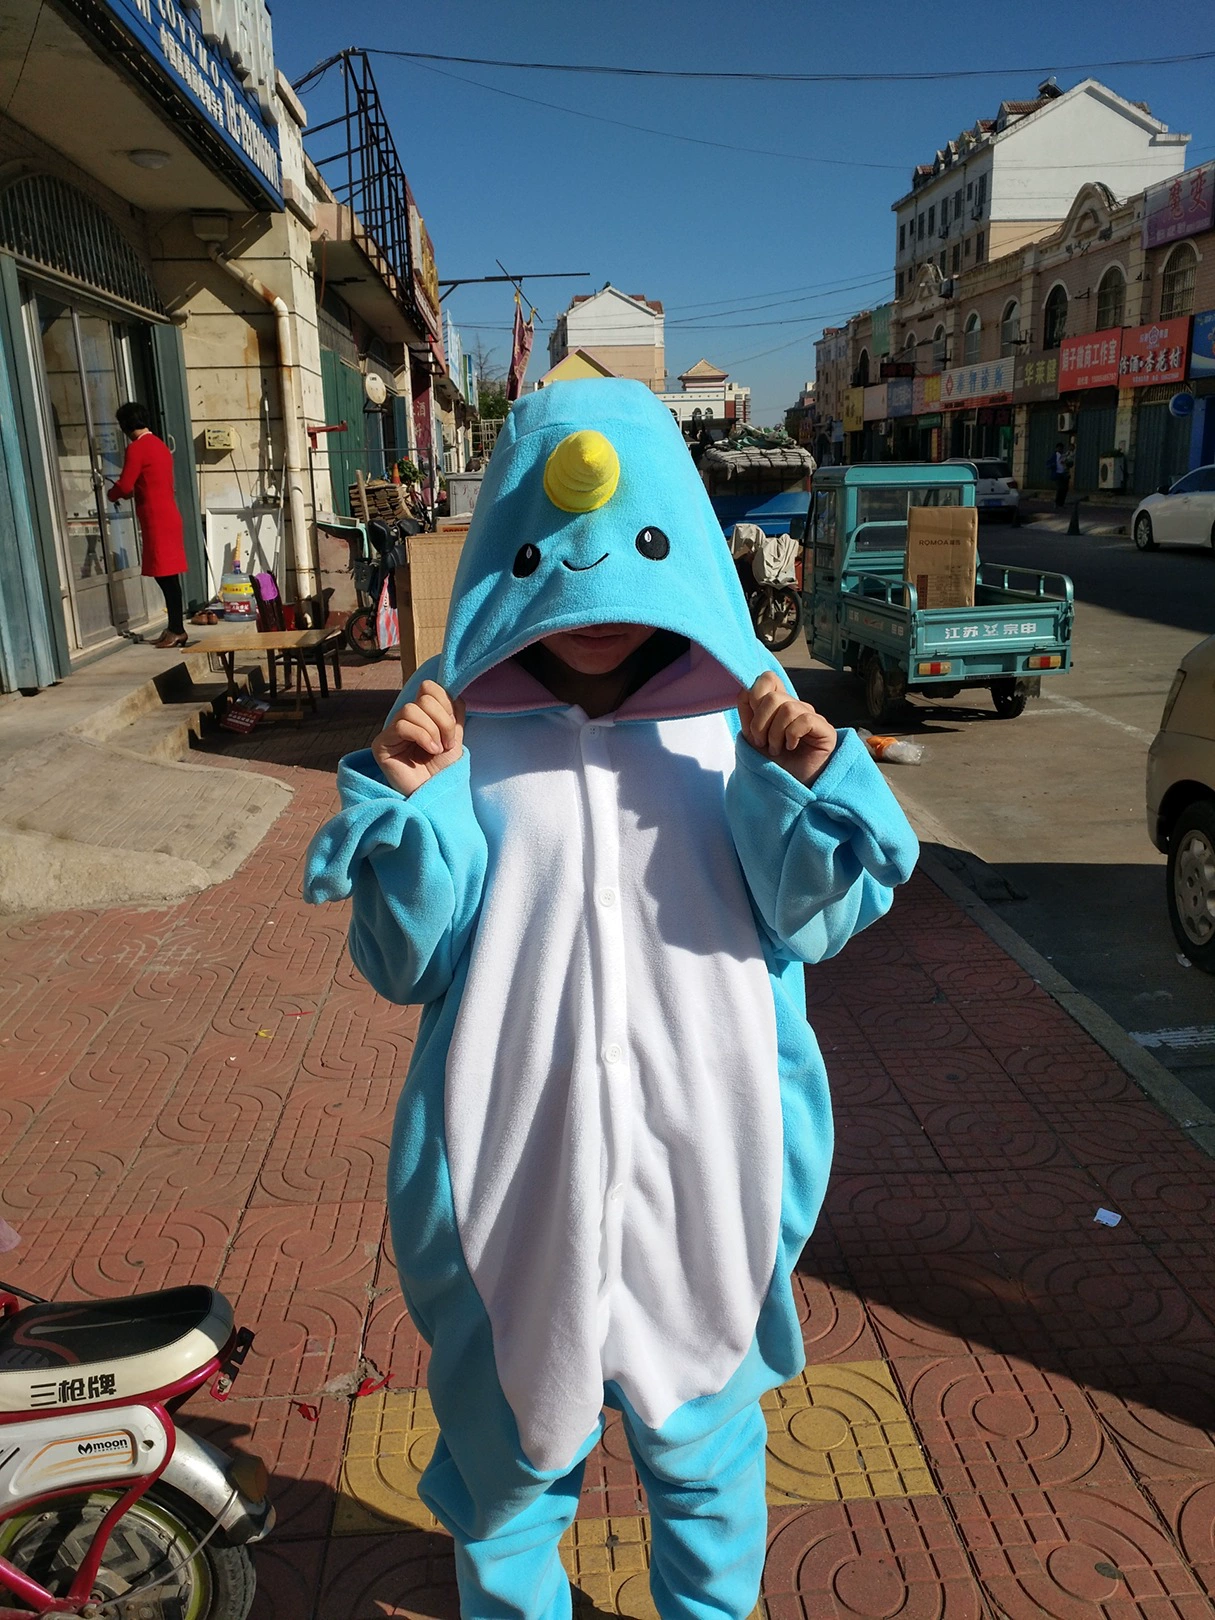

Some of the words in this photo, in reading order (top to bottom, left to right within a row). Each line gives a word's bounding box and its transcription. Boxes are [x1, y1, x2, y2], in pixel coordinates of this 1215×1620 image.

[945, 626, 979, 640] 江苏
[1003, 622, 1037, 636] 宗申
[30, 1373, 117, 1407] 三枪牌
